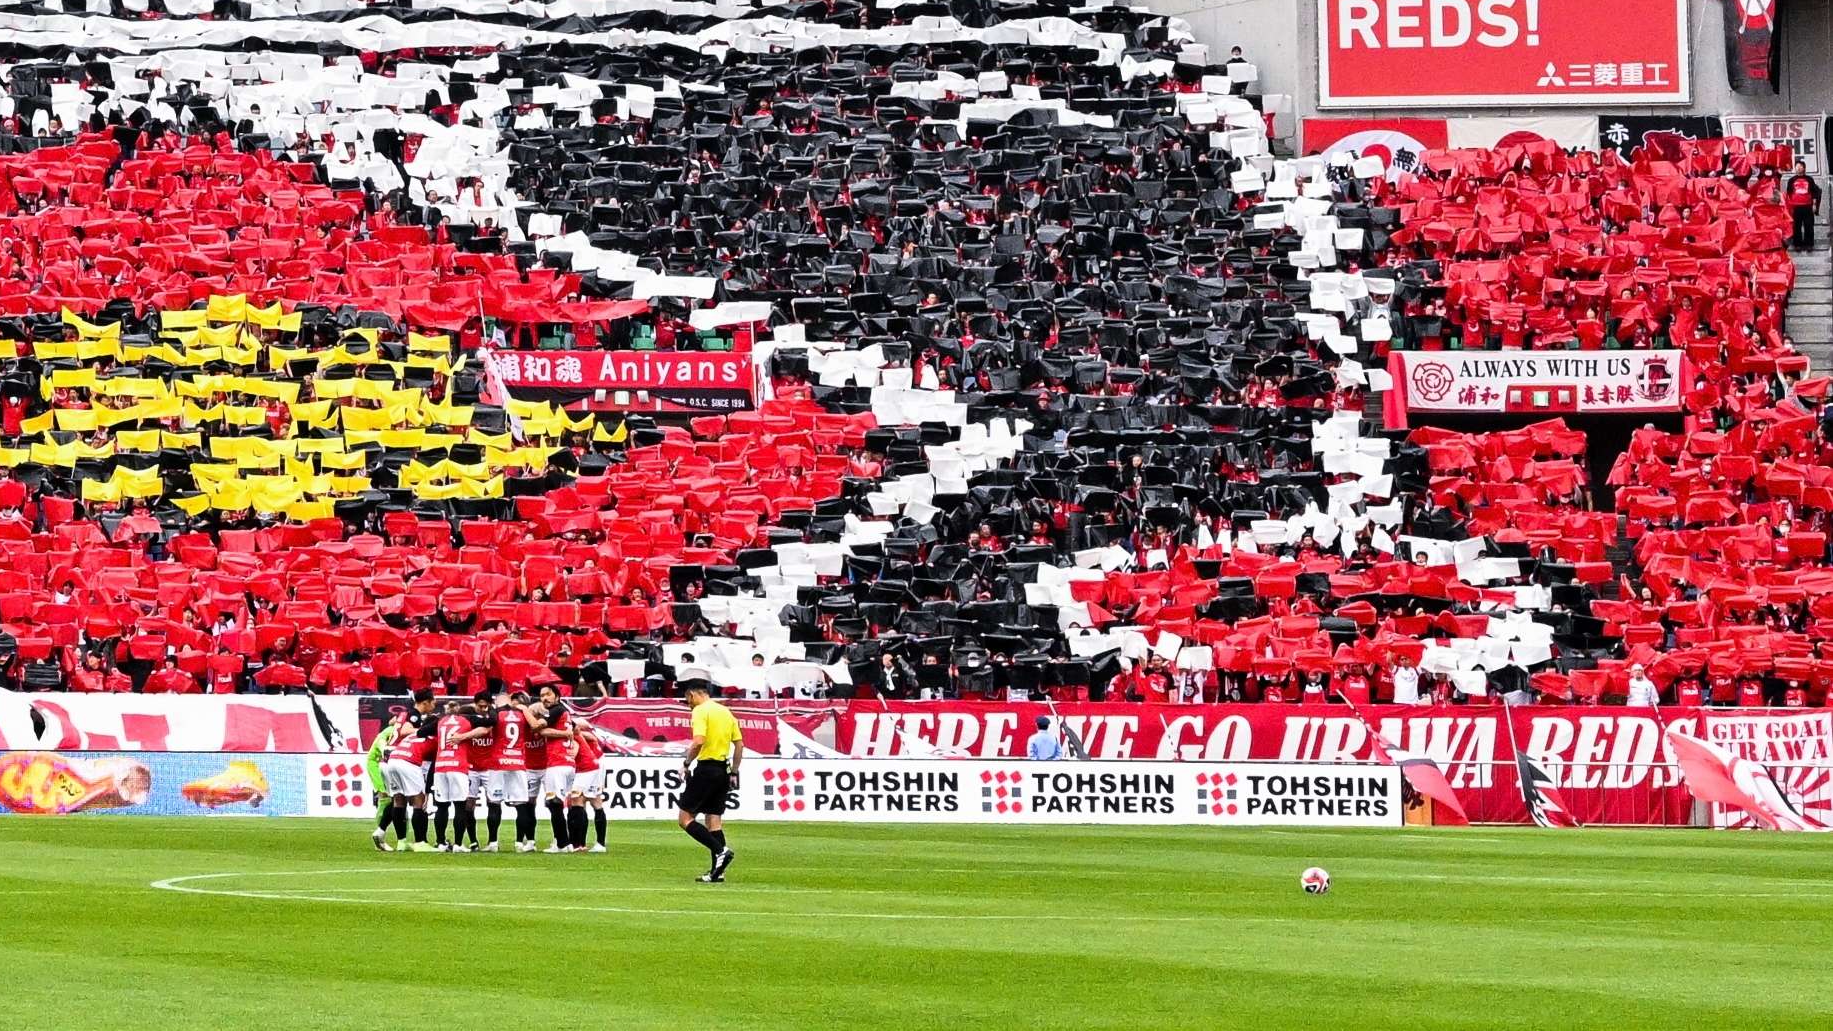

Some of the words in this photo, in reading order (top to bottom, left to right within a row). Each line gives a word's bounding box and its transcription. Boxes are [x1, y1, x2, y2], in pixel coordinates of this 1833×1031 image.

[1569, 62, 1669, 87] 三菱重工
[1744, 122, 1804, 139] REDS
[1460, 359, 1537, 378] ALWAYS
[1547, 358, 1599, 377] WITH
[1607, 357, 1631, 376] US
[1457, 384, 1501, 406] 浦和
[646, 717, 669, 728] THE
[1712, 722, 1758, 740] GET
[1766, 720, 1827, 740] GOAL
[505, 722, 520, 749] 9
[814, 770, 960, 793] TOHSHIN
[1032, 772, 1175, 795] TOHSHIN
[1247, 774, 1389, 797] TOHSHIN
[814, 792, 960, 813] PARTNERS
[1032, 794, 1175, 815] PARTNERS
[1247, 797, 1389, 817] PARTNERS
